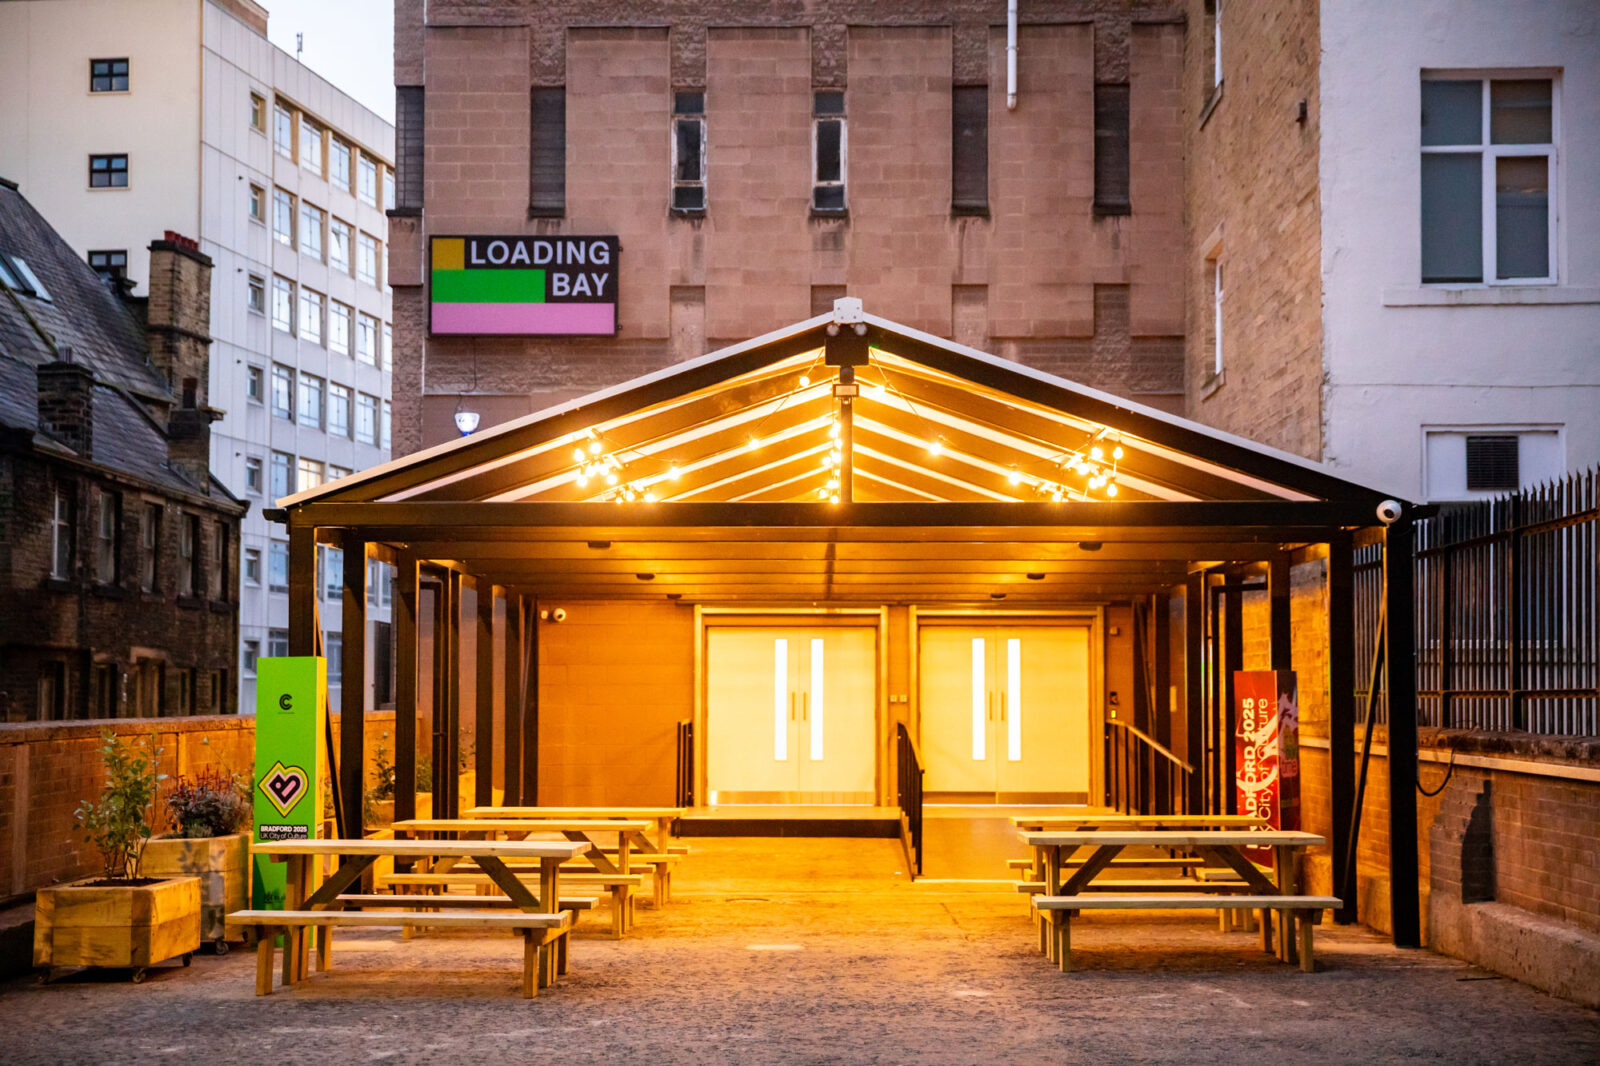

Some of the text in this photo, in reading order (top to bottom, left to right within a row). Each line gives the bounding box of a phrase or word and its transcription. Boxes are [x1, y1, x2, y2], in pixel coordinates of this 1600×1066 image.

[471, 240, 610, 265] LOADING
[552, 273, 609, 297] BAY
[1257, 698, 1269, 760] Cuure
[1242, 697, 1258, 849] DFORD 2025
[1258, 787, 1273, 820] City
[293, 825, 308, 833] 2025
